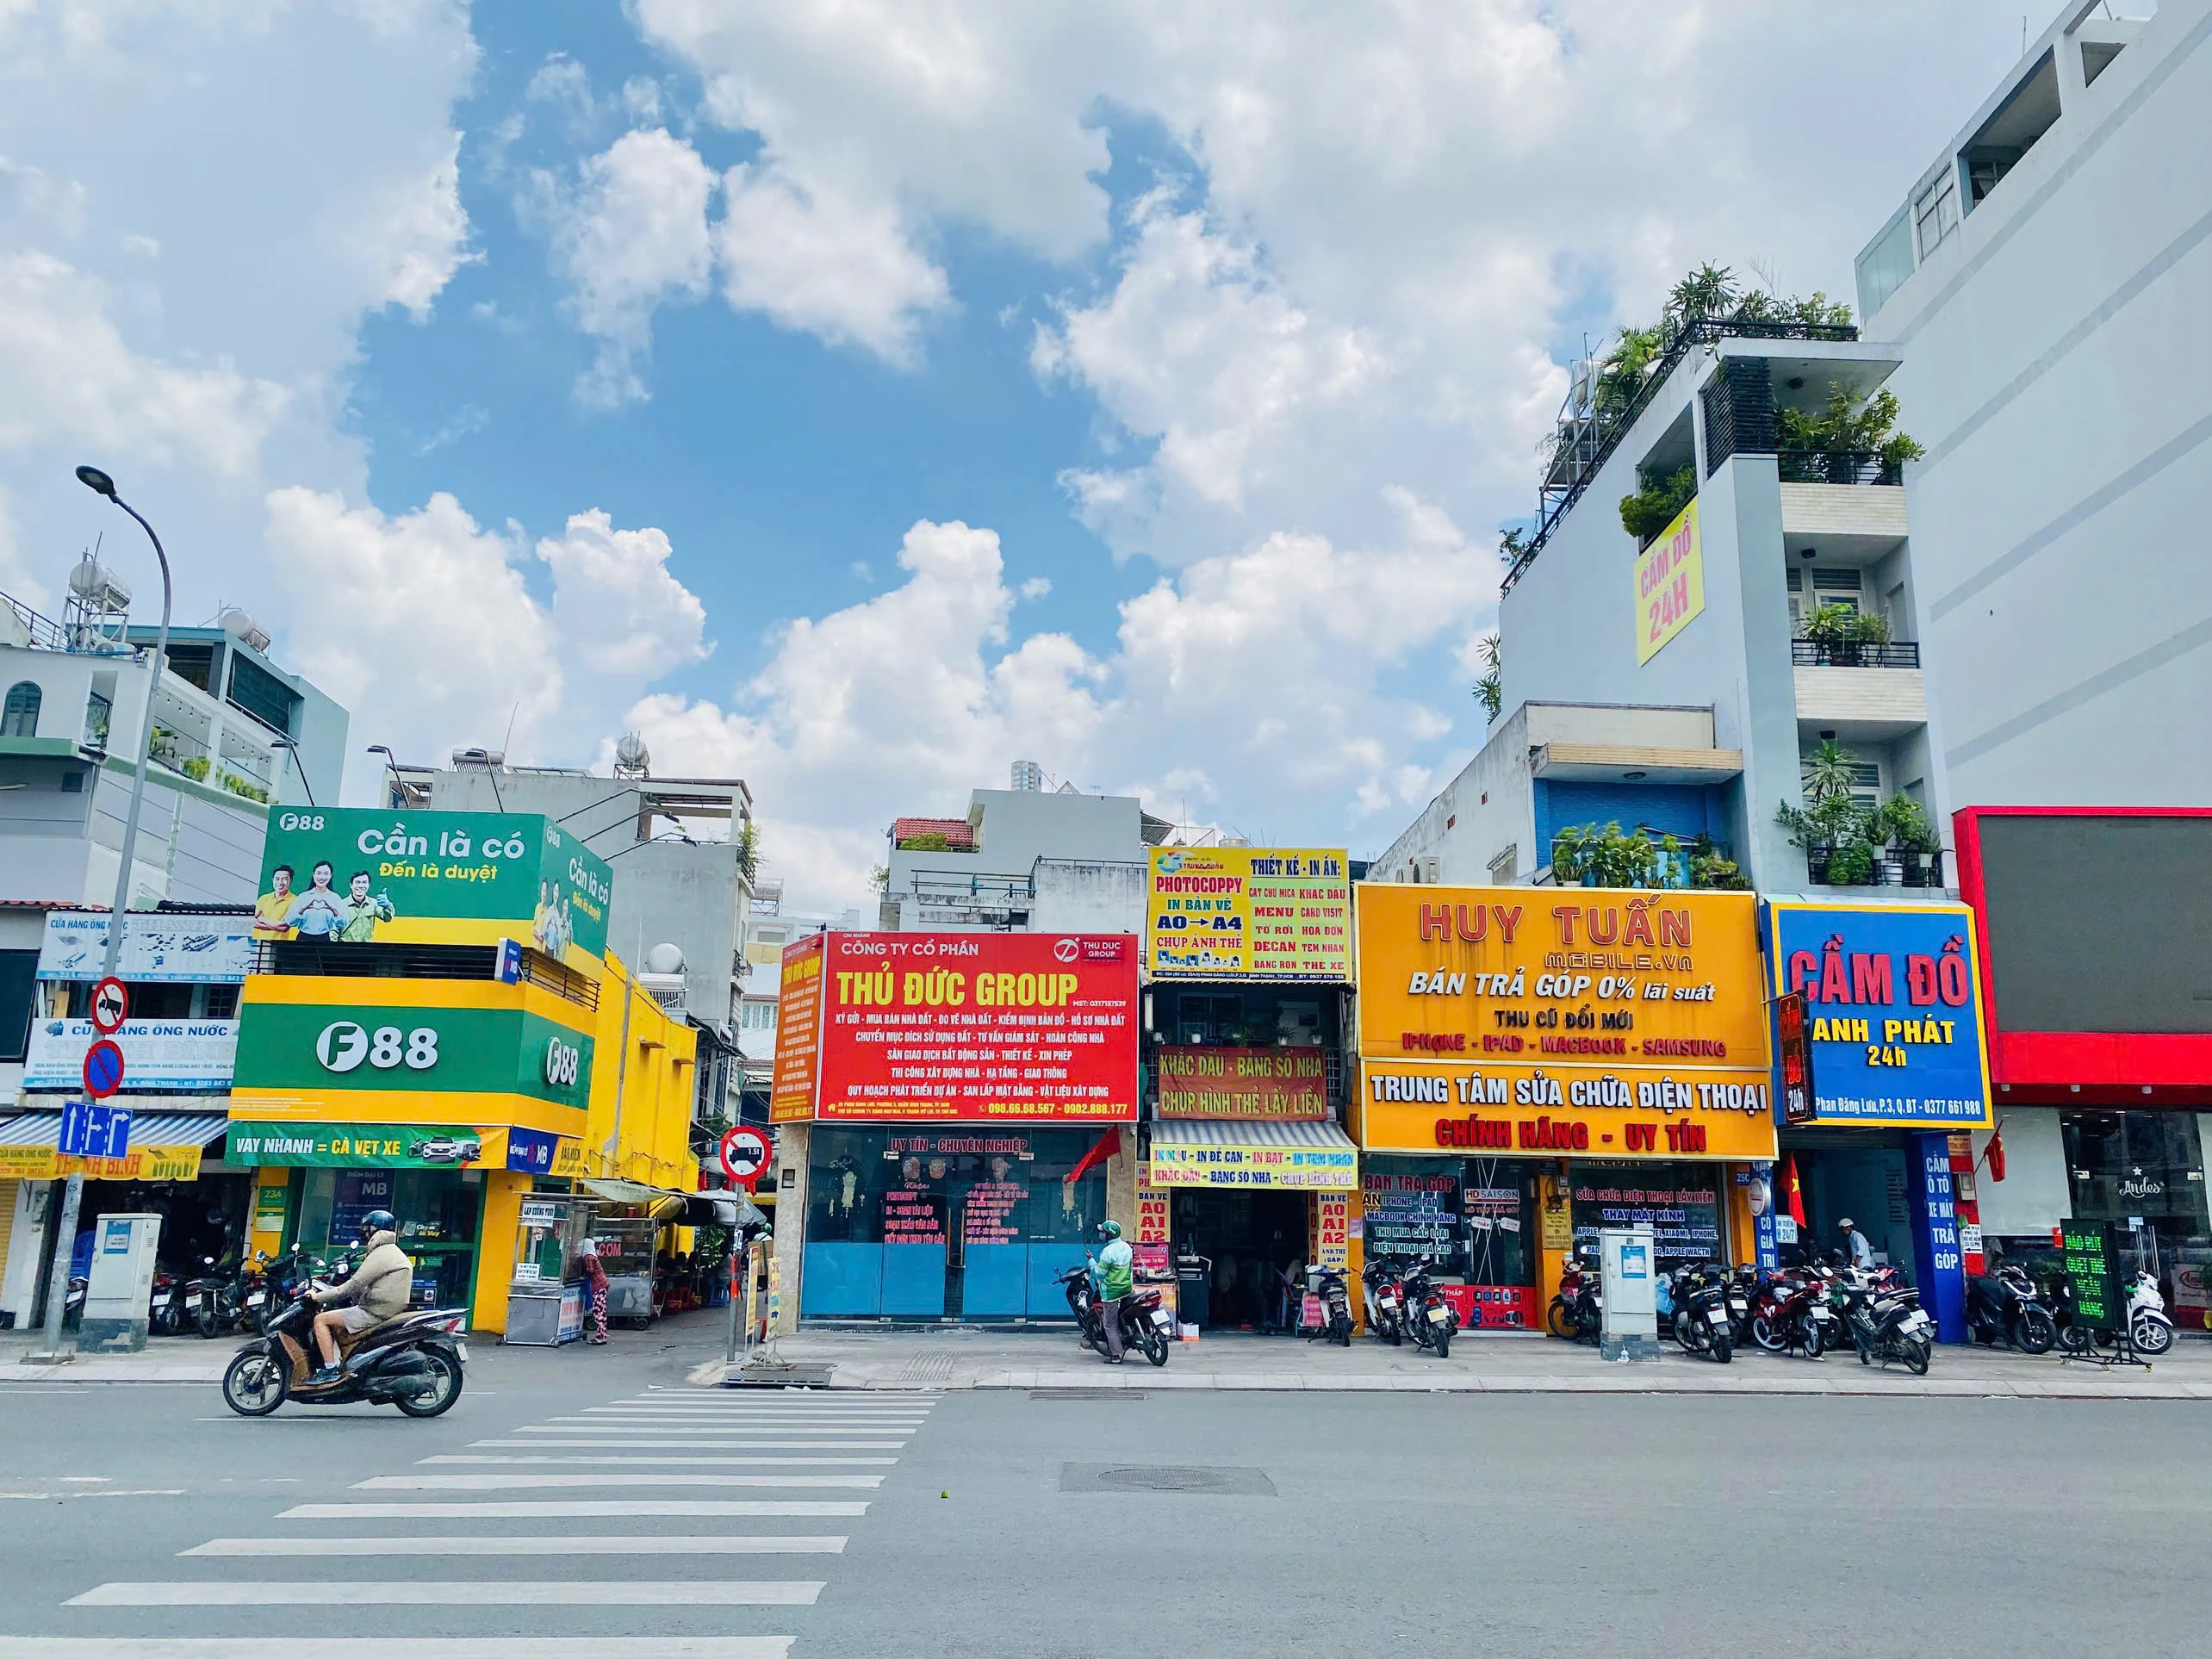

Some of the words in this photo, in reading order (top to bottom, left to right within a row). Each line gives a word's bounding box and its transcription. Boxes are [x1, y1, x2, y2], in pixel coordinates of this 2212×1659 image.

[1673, 512, 1692, 567] ĐỒ
[1649, 570, 1688, 644] 24H
[279, 812, 325, 831] F88
[357, 822, 427, 855] Cần
[439, 830, 469, 857] là
[482, 831, 524, 859] có
[379, 860, 417, 878] Đến
[422, 864, 439, 878] là
[444, 866, 497, 880] duyệt
[1251, 854, 1282, 875] THIẾT
[1286, 854, 1299, 875] KẾ
[1309, 860, 1320, 875] IN
[569, 855, 587, 891] Cần
[590, 871, 597, 898] là
[599, 882, 609, 904] có
[1156, 876, 1242, 893] PHOTOCOPPY
[1168, 899, 1180, 910] IN
[1185, 896, 1211, 910] BẢN
[1216, 898, 1232, 910] VẼ
[1280, 889, 1295, 898] MICA
[1254, 907, 1294, 916] MENU
[1301, 908, 1320, 916] CARD
[1323, 908, 1343, 917] VISIT
[1420, 902, 1524, 942] HUY
[1552, 893, 1693, 947] TUẤN
[1212, 916, 1242, 929] A4
[841, 940, 886, 955] CÔNG
[891, 943, 909, 955] TY
[912, 939, 935, 955] CỔ
[939, 939, 979, 955] PHẦN
[1157, 937, 1187, 949] CHỤP
[1191, 933, 1216, 948] ẢNH
[1220, 934, 1242, 948] THẺ
[1254, 941, 1296, 951] DECAN
[1790, 933, 1894, 1004] CẦM
[1908, 935, 1968, 1006] ĐỒ
[836, 960, 894, 1005] THỦ
[904, 965, 966, 1006] ĐỨC
[976, 972, 1078, 1007] GROUP
[1408, 966, 1465, 996] BÁN
[1475, 966, 1525, 997] TRẢ
[1536, 968, 1592, 998] GÓP
[1597, 976, 1634, 999] 0%
[1643, 983, 1668, 999] lãi
[1673, 981, 1716, 1001] suất
[1494, 1010, 1530, 1027] THU
[1536, 1007, 1557, 1028] CŨ
[1564, 1003, 1594, 1028] ĐỔI
[1600, 1010, 1633, 1029] MỚI
[152, 1023, 182, 1035] ỐNG
[188, 1025, 227, 1035] NƯỚC
[1812, 1017, 1869, 1042] ANH
[1884, 1014, 1955, 1043] PHÁT
[316, 1021, 438, 1072] F88
[904, 1050, 921, 1059] GIAO
[923, 1050, 940, 1062] DỊCH
[942, 1047, 955, 1060] BẤT
[958, 1048, 977, 1062] ĐỘNG
[979, 1047, 994, 1060] SẢN
[1002, 1048, 1021, 1060] THIẾT
[1022, 1047, 1033, 1060] KẾ
[1039, 1051, 1051, 1060] XIN
[1053, 1049, 1072, 1060] PHÉP
[1402, 1034, 1465, 1051] IPHONE
[1483, 1035, 1524, 1052] IPAD
[1540, 1036, 1626, 1054] MACBOOK
[1643, 1040, 1726, 1057] SAMSUNG
[545, 1036, 579, 1086] F88
[1160, 1051, 1195, 1076] KHẮC
[1198, 1049, 1225, 1076] DẤU
[1237, 1049, 1271, 1076] BẢNG
[1276, 1049, 1293, 1077] SỐ
[1296, 1052, 1323, 1077] NHÀ
[1867, 1046, 1907, 1066] 24h
[1162, 1090, 1196, 1115] CHỤP
[1200, 1087, 1231, 1113] HÌNH
[1235, 1085, 1260, 1114] THẺ
[1264, 1085, 1289, 1114] LẤY
[1294, 1084, 1323, 1114] LIỀN
[1371, 1075, 1448, 1103] TRUNG
[1455, 1072, 1508, 1103] TÂM
[1516, 1069, 1563, 1106] SỬA
[1571, 1075, 1632, 1108] CHỮA
[1637, 1077, 1692, 1115] ĐIỆN
[1697, 1084, 1768, 1115] THOẠI
[1788, 1088, 1804, 1112] 24h
[989, 1103, 1054, 1114] 096.66.68.567
[1064, 1103, 1128, 1114] 0902.888.177
[1816, 1097, 1836, 1112] Phan
[1838, 1097, 1860, 1114] Đăng
[1924, 1099, 1946, 1114] 0377
[1948, 1100, 1963, 1114] 661
[1965, 1100, 1980, 1115] 988
[1436, 1114, 1513, 1147] CHÍNH
[1519, 1116, 1588, 1149] HÃNG
[1625, 1123, 1657, 1150] UY
[1666, 1118, 1706, 1152] TÍN
[236, 1138, 261, 1153] VAY
[264, 1139, 314, 1153] NHANH
[331, 1137, 350, 1155] CÀ
[355, 1140, 379, 1158] VẸT
[382, 1140, 401, 1155] XE
[536, 1145, 547, 1165] MB
[892, 1139, 906, 1151] UY
[910, 1136, 928, 1152] TÍN
[938, 1137, 983, 1153] CHUYÊN
[985, 1137, 1028, 1155] NGHIỆP
[1926, 1151, 1950, 1172] CẦM
[1737, 1173, 1749, 1182] 25C
[1928, 1177, 1935, 1193] Ô
[1937, 1175, 1949, 1193] TÔ
[264, 1190, 282, 1199] 23A
[362, 1182, 387, 1196] MB
[1383, 1196, 1412, 1206] IPHONE
[1420, 1198, 1438, 1208] IPAD
[1929, 1202, 1937, 1217] XE
[1939, 1199, 1954, 1218] MÁY
[1322, 1218, 1345, 1230] A1
[1366, 1211, 1407, 1221] MACBOOK
[1603, 1209, 1630, 1221] THAY
[1657, 1208, 1685, 1221] KÍNH
[1761, 1213, 1771, 1230] CÓ
[1322, 1232, 1345, 1244] A2
[1761, 1233, 1774, 1249] GIÁ
[1932, 1223, 1955, 1244] TRẢ
[1665, 1247, 1687, 1256] APPLE
[1687, 1248, 1710, 1257] WACTH
[1935, 1249, 1958, 1269] GÓP
[1762, 1253, 1775, 1271] TRỊ
